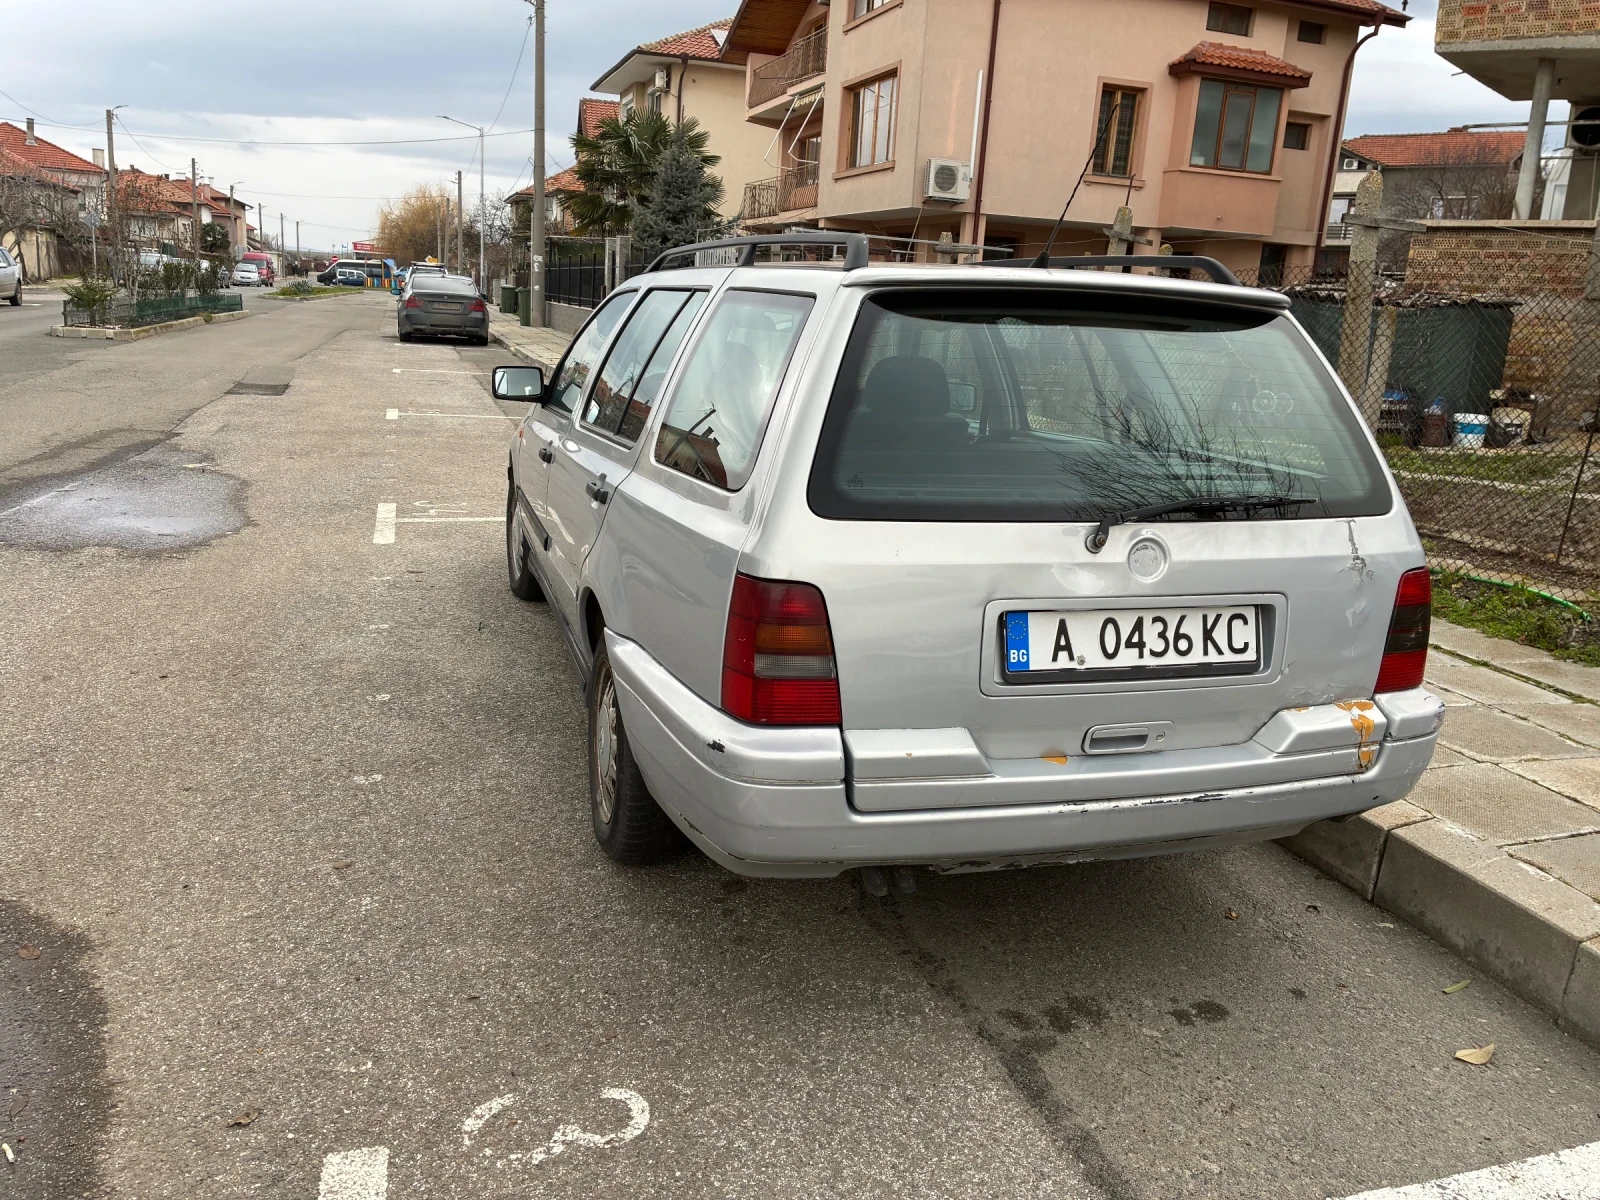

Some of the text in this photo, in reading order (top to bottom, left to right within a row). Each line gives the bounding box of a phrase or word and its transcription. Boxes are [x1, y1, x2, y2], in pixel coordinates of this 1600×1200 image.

[1051, 618, 1075, 662] A
[1100, 614, 1193, 660] 0436
[1010, 649, 1028, 663] BG
